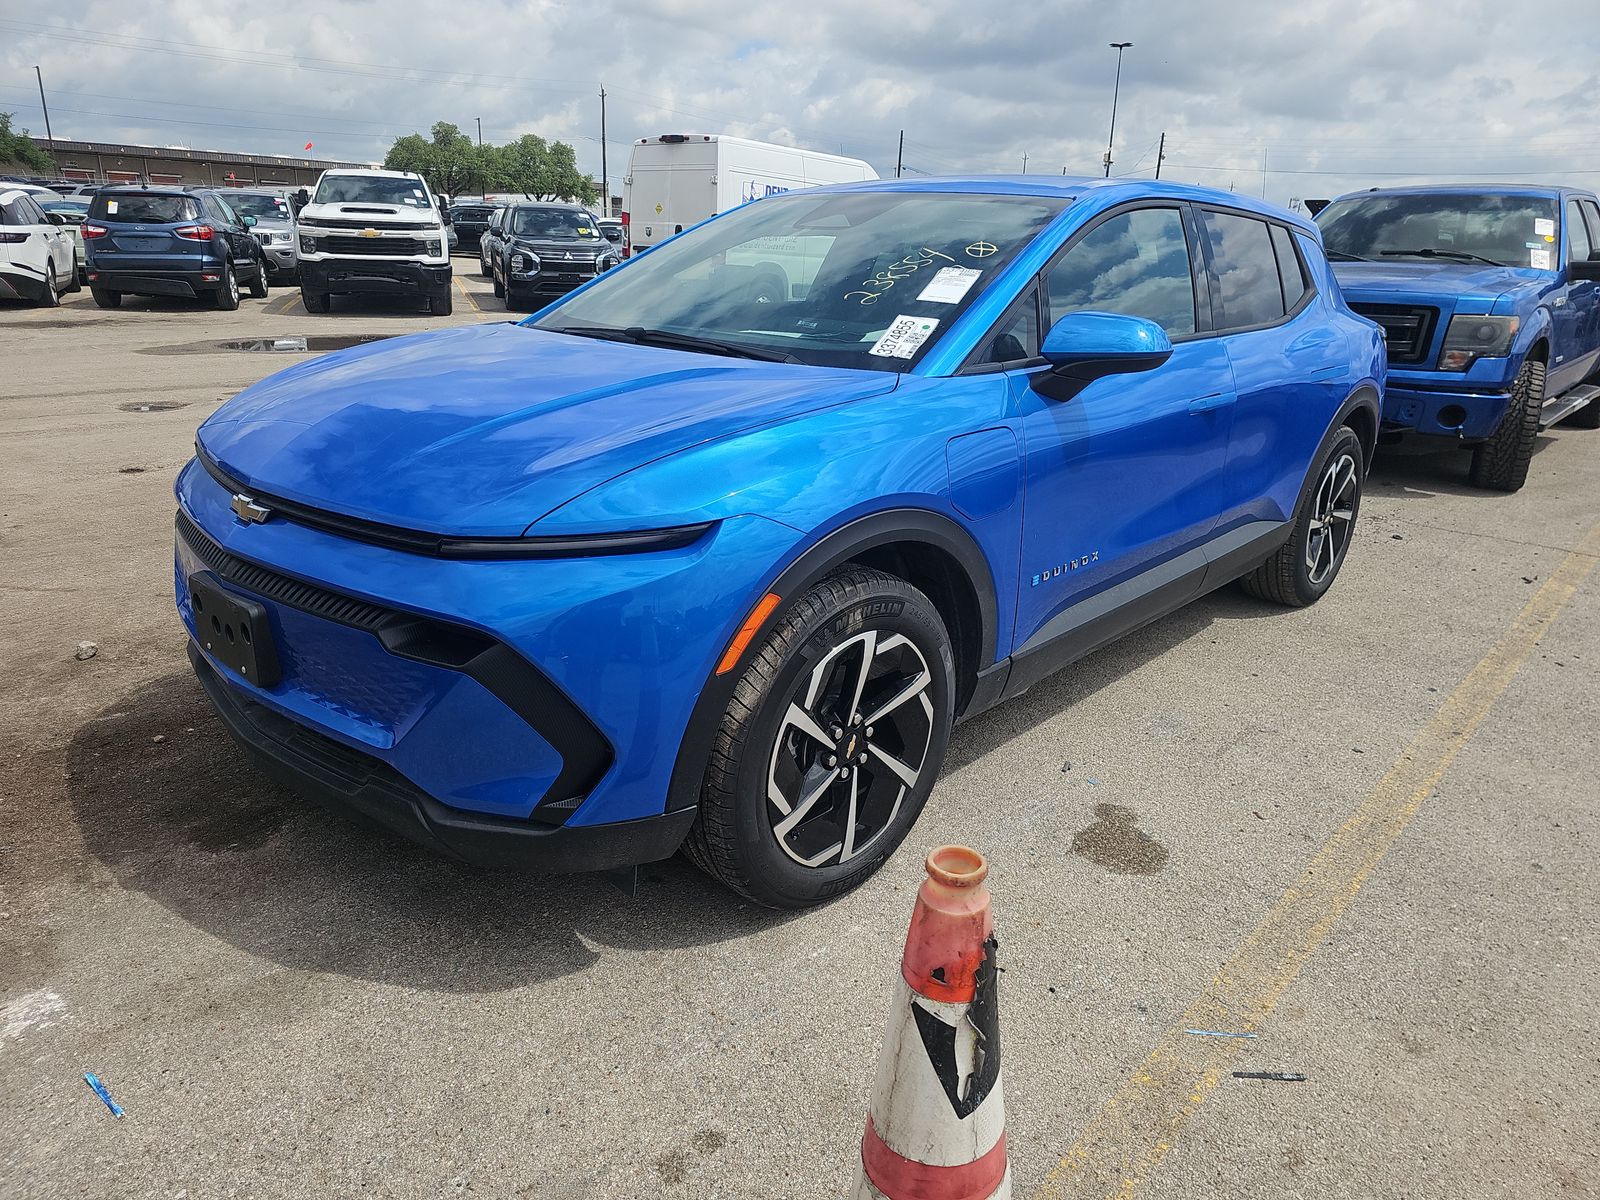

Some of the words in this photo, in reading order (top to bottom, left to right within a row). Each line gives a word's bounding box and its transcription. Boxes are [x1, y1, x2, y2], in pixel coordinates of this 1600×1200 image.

[876, 320, 915, 354] 3374855
[1031, 551, 1099, 587] EQUINOX
[835, 601, 902, 632] MICHELIN
